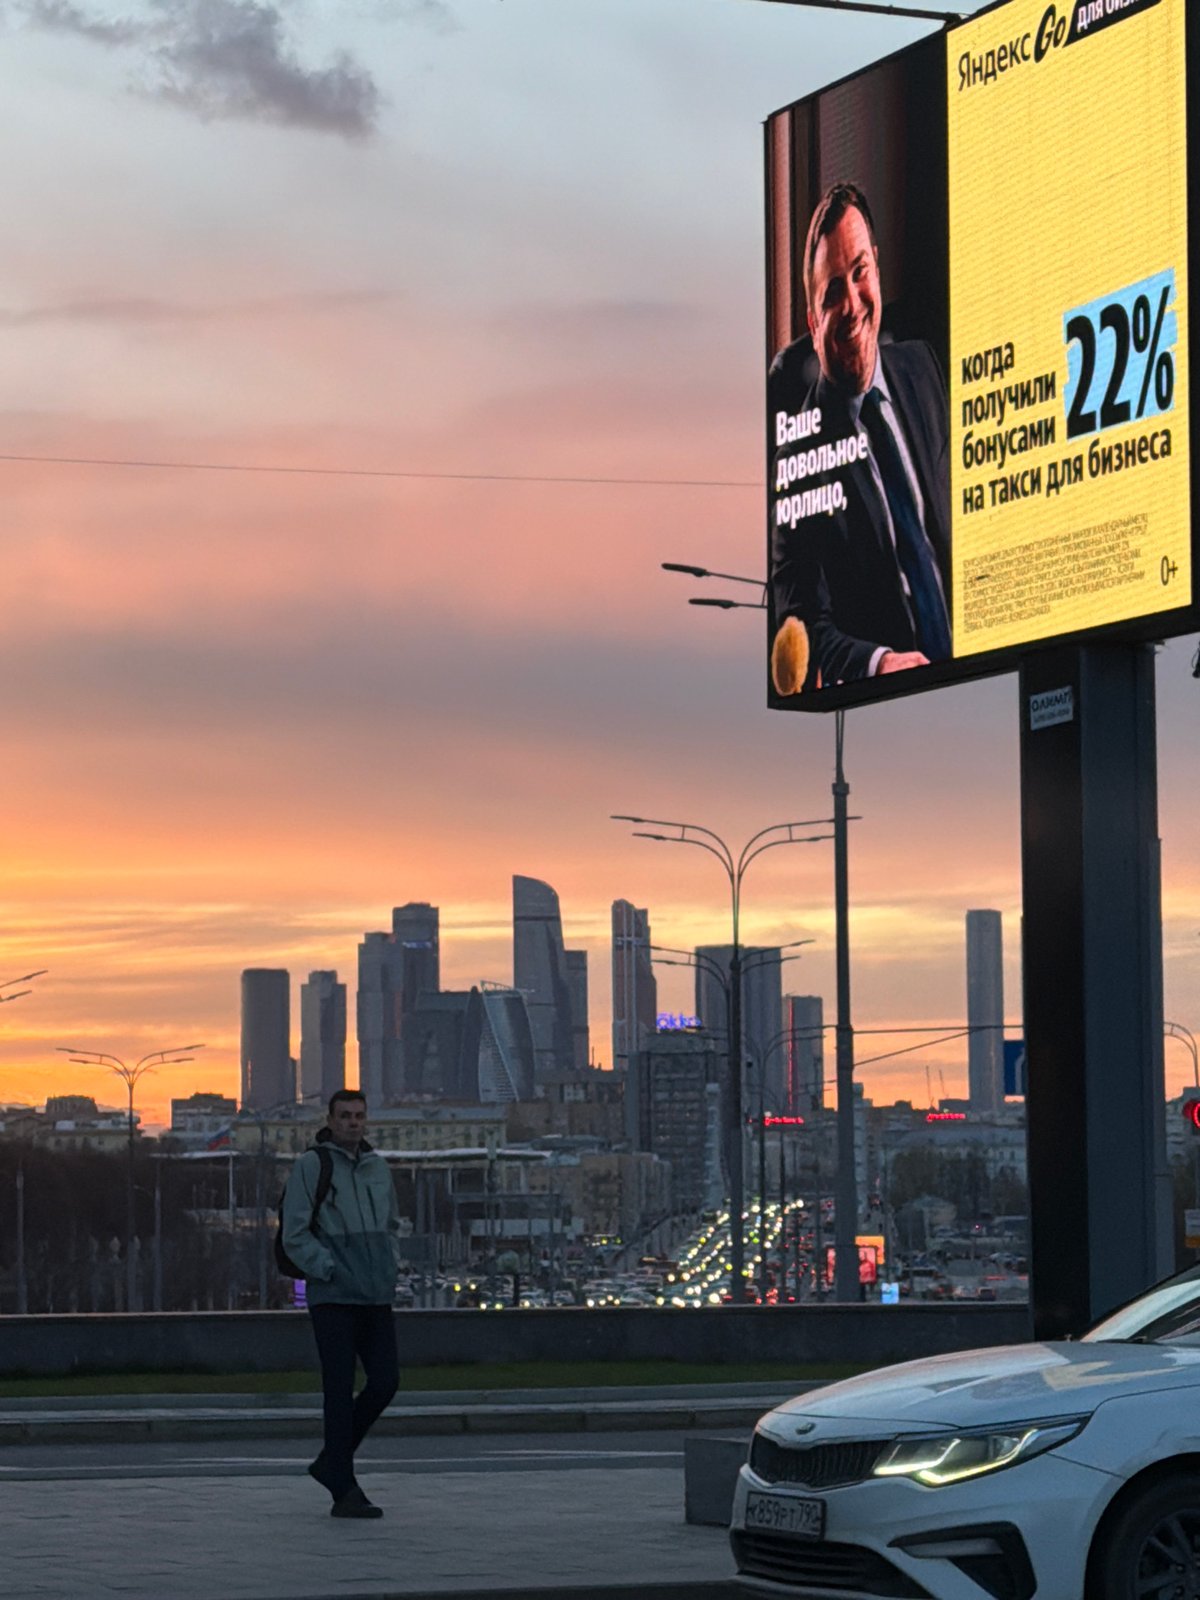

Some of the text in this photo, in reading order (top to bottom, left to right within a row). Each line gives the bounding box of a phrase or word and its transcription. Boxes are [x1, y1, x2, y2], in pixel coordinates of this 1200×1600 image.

[958, 33, 1031, 91] Яндекс
[1034, 4, 1066, 63] Go
[1077, 0, 1103, 33] для
[962, 342, 1015, 385] когда
[1066, 284, 1174, 440] 22%
[776, 407, 822, 446] Ваше
[962, 371, 1056, 427] получили
[776, 432, 868, 492] довольное
[962, 416, 1056, 470] бонусами
[963, 428, 1172, 514] на такси для бизнеса
[776, 481, 848, 529] юрлицо,
[1160, 555, 1178, 586] 0+
